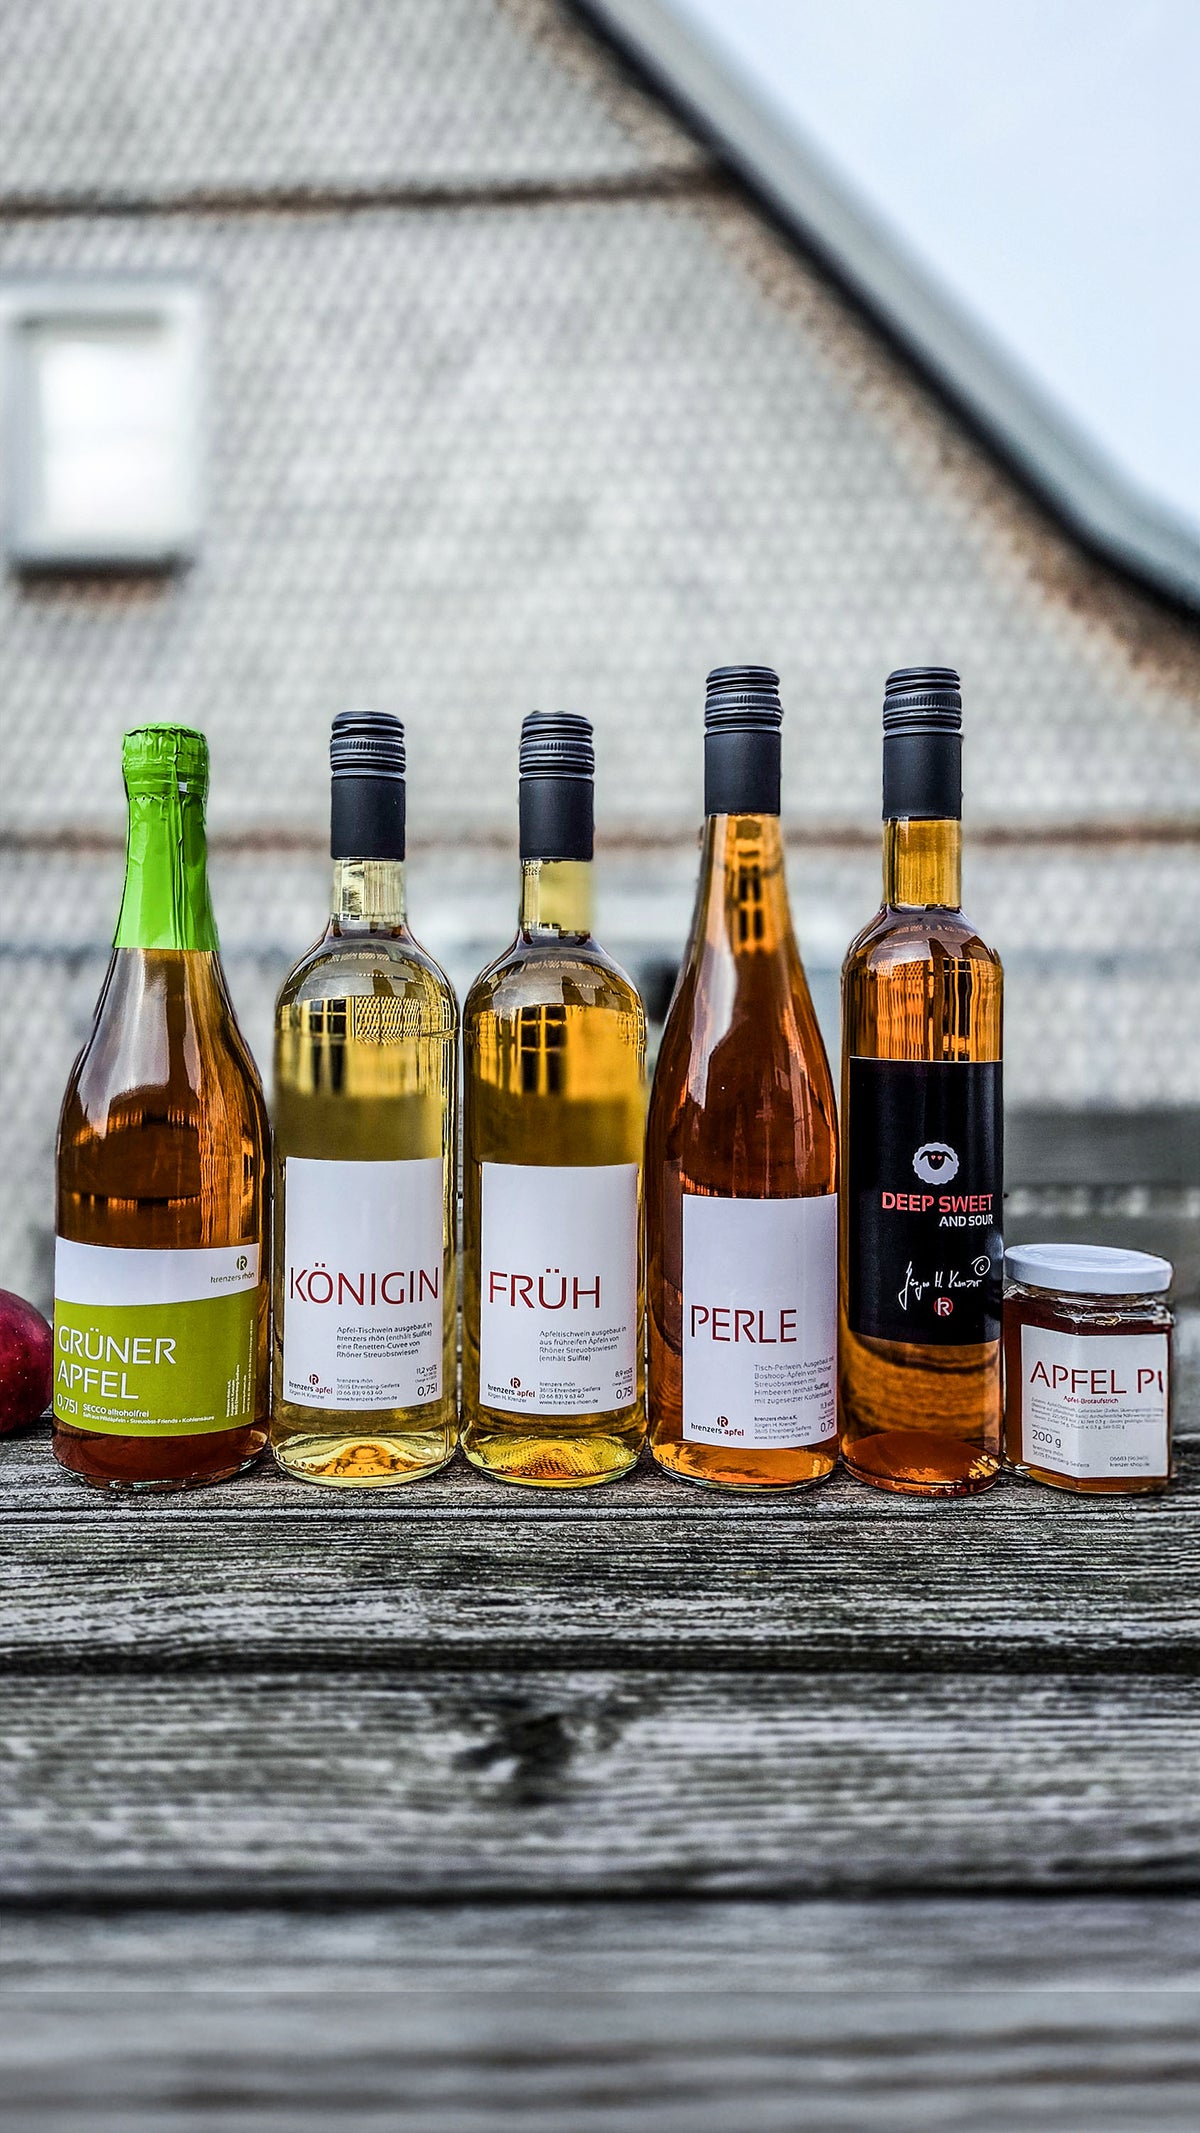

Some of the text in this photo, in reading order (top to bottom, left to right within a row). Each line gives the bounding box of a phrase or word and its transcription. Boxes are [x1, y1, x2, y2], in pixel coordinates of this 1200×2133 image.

[882, 1192, 993, 1212] DEEP SWEET
[938, 1214, 993, 1227] AND SOUR
[290, 1262, 438, 1306] KÖNIGIN
[490, 1268, 600, 1310] FRÜH
[691, 1304, 797, 1344] PERLE
[58, 1325, 177, 1364] GRÜNER
[58, 1360, 139, 1400] APFEL
[1030, 1361, 1127, 1395] APFEL
[315, 1386, 333, 1394] apfel
[417, 1382, 437, 1396] 0,75l
[516, 1389, 536, 1398] apfel
[57, 1394, 78, 1414] 0,75l
[83, 1404, 106, 1414] SECCO
[724, 1428, 744, 1436] apfel
[1032, 1429, 1062, 1448] 200 g
